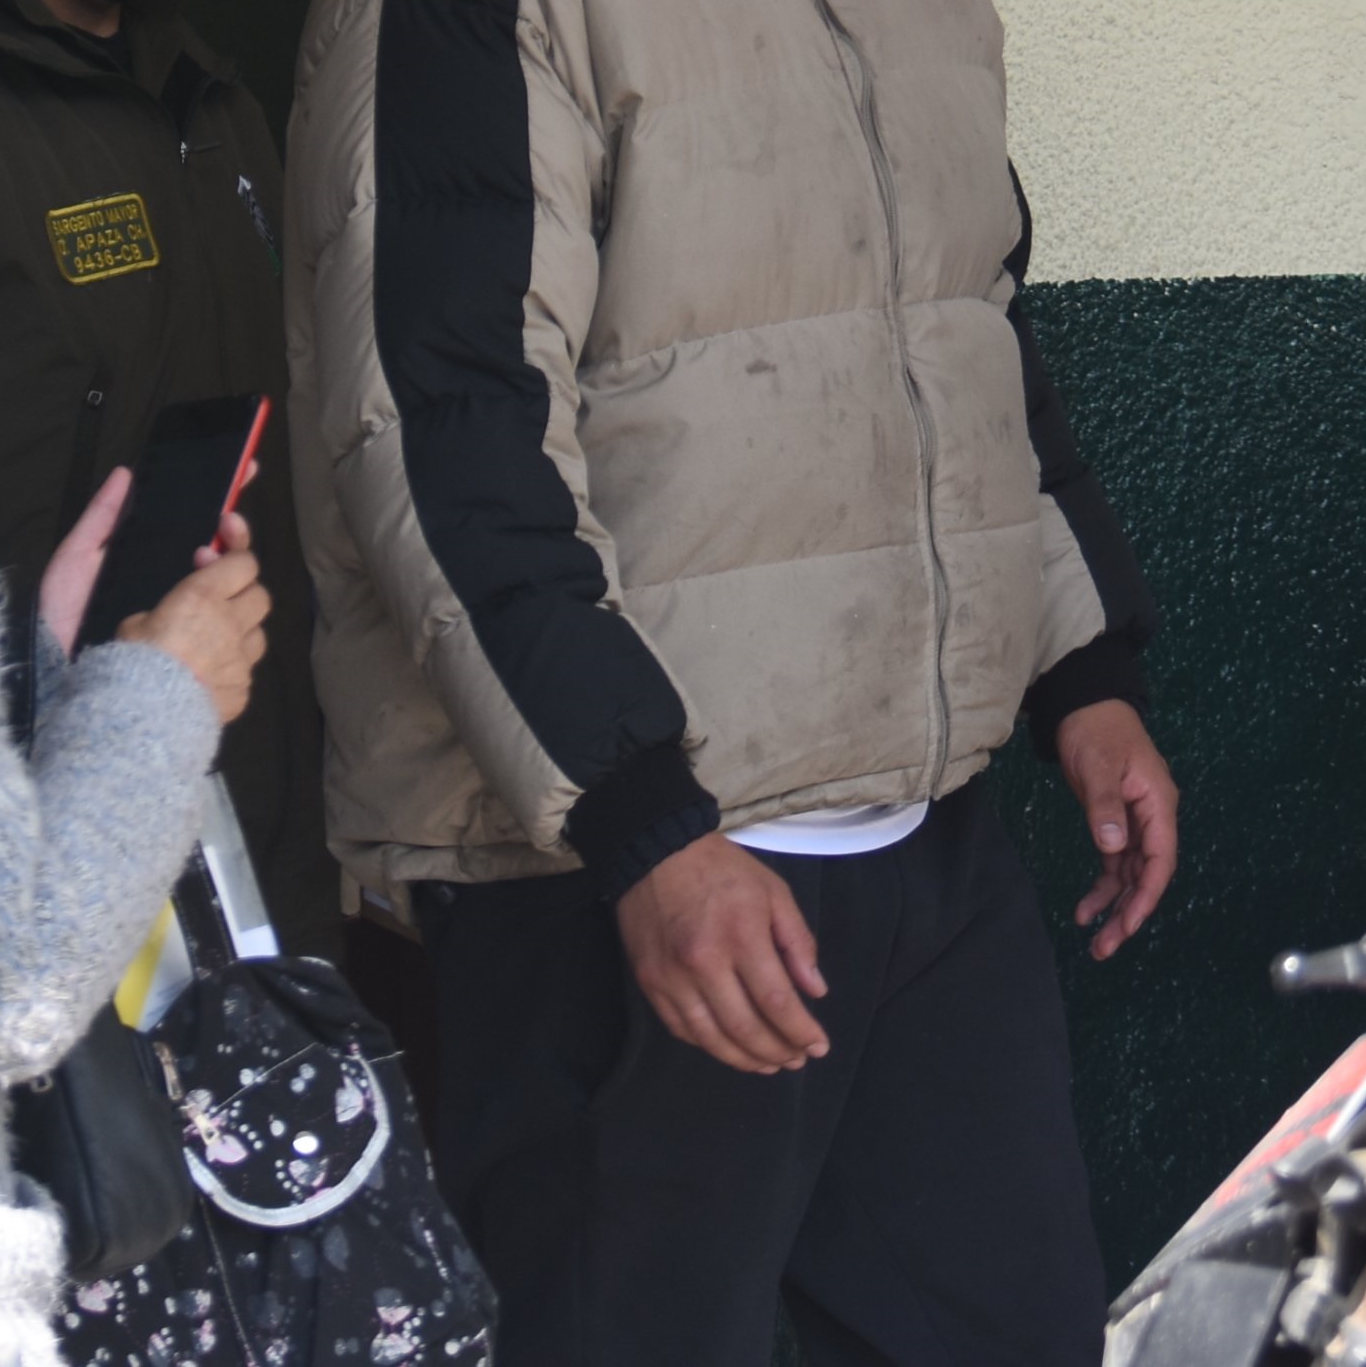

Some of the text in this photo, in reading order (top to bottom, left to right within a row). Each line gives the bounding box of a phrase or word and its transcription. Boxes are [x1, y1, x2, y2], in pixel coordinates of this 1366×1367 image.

[52, 204, 138, 236] SARGENTO MAYOR
[76, 228, 124, 253] APAZA
[74, 243, 142, 273] 9436-CB
